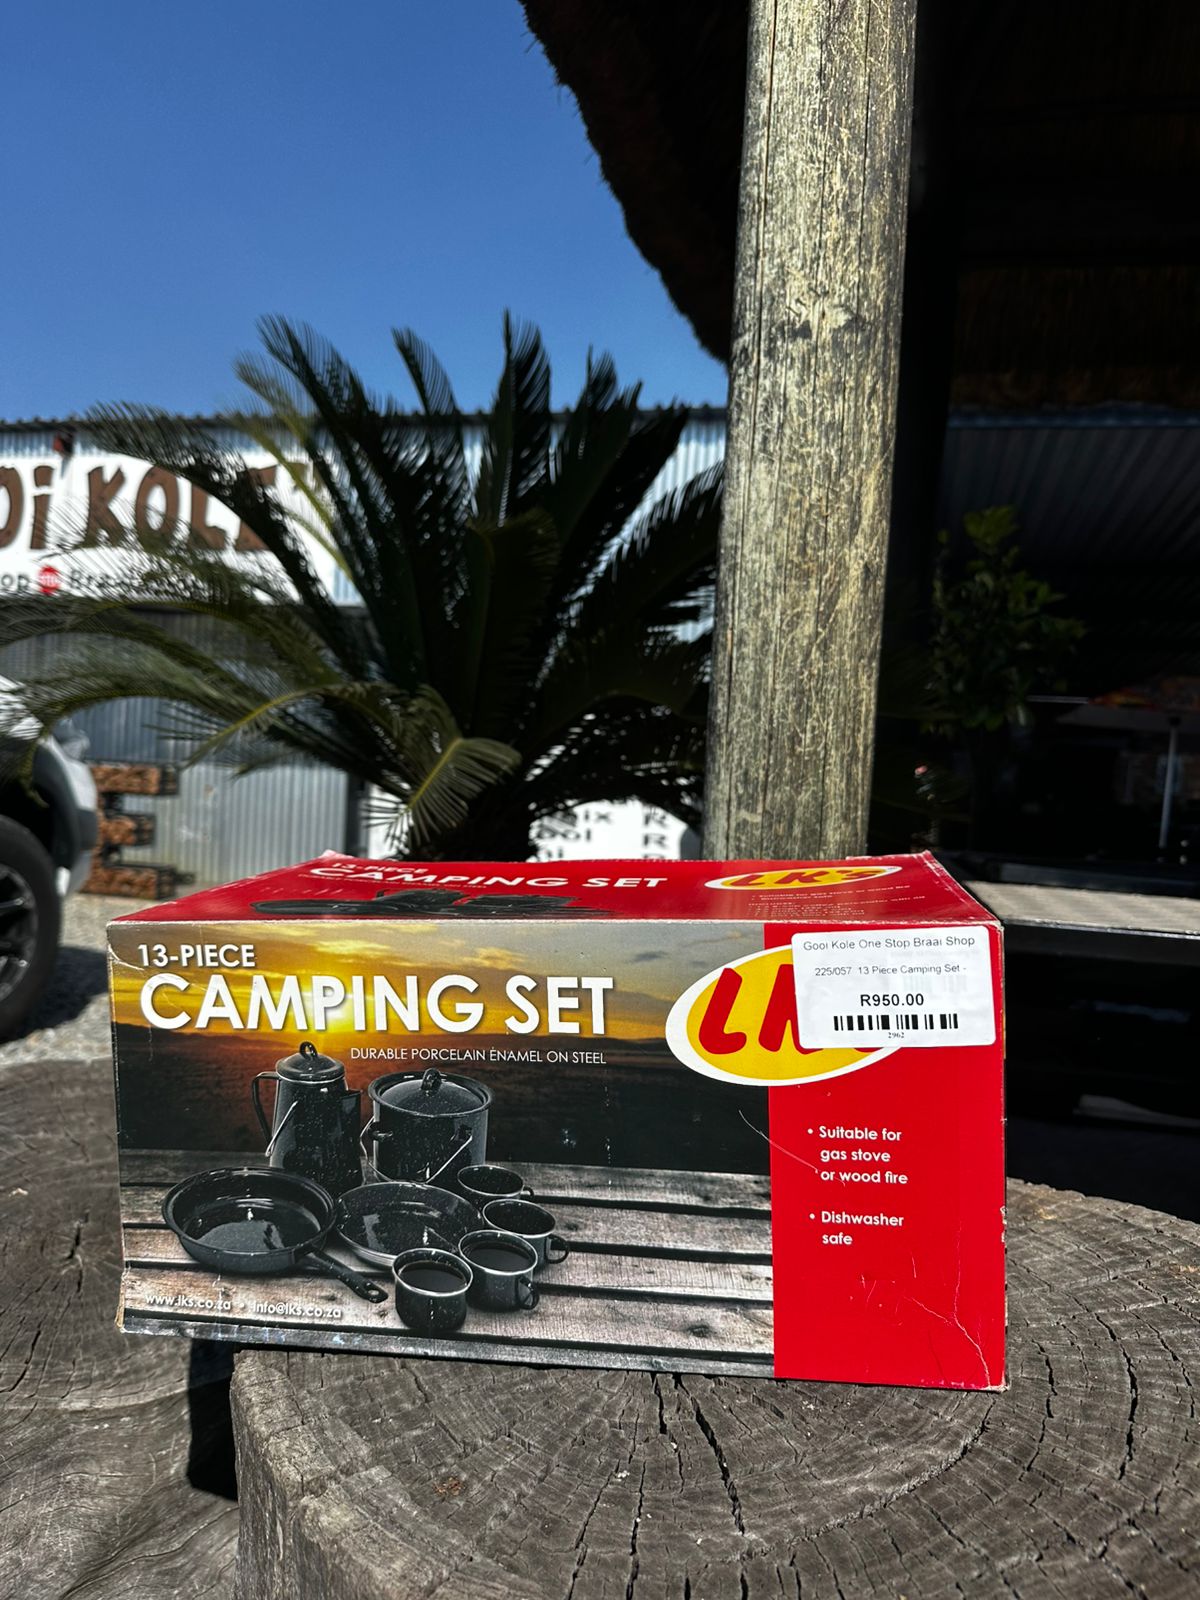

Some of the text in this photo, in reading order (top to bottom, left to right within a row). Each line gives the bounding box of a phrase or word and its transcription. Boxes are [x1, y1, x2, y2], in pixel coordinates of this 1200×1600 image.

[332, 862, 429, 874] 13-PIECE
[310, 867, 569, 887] CAMPING
[582, 877, 668, 888] SET
[803, 935, 976, 951] Gooi Kole One Stop Braai Shop
[137, 944, 256, 968] 13-PIECE
[814, 966, 853, 977] 225/057
[858, 966, 870, 975] 13
[872, 965, 898, 975] Piece
[900, 964, 942, 976] Camping
[944, 963, 961, 973] Set
[140, 972, 614, 1036] CAMPING SET
[860, 992, 925, 1007] R950.00
[350, 1047, 607, 1065] DURABLE PORCELAIN ENAMEL ON STEEL
[819, 1126, 903, 1142] Suitable for
[820, 1148, 892, 1163] gas stove
[820, 1171, 909, 1185] or wood fire
[821, 1211, 905, 1227] Dishwasher
[822, 1232, 853, 1246] safe
[145, 1294, 231, 1311] www.lks.co.za
